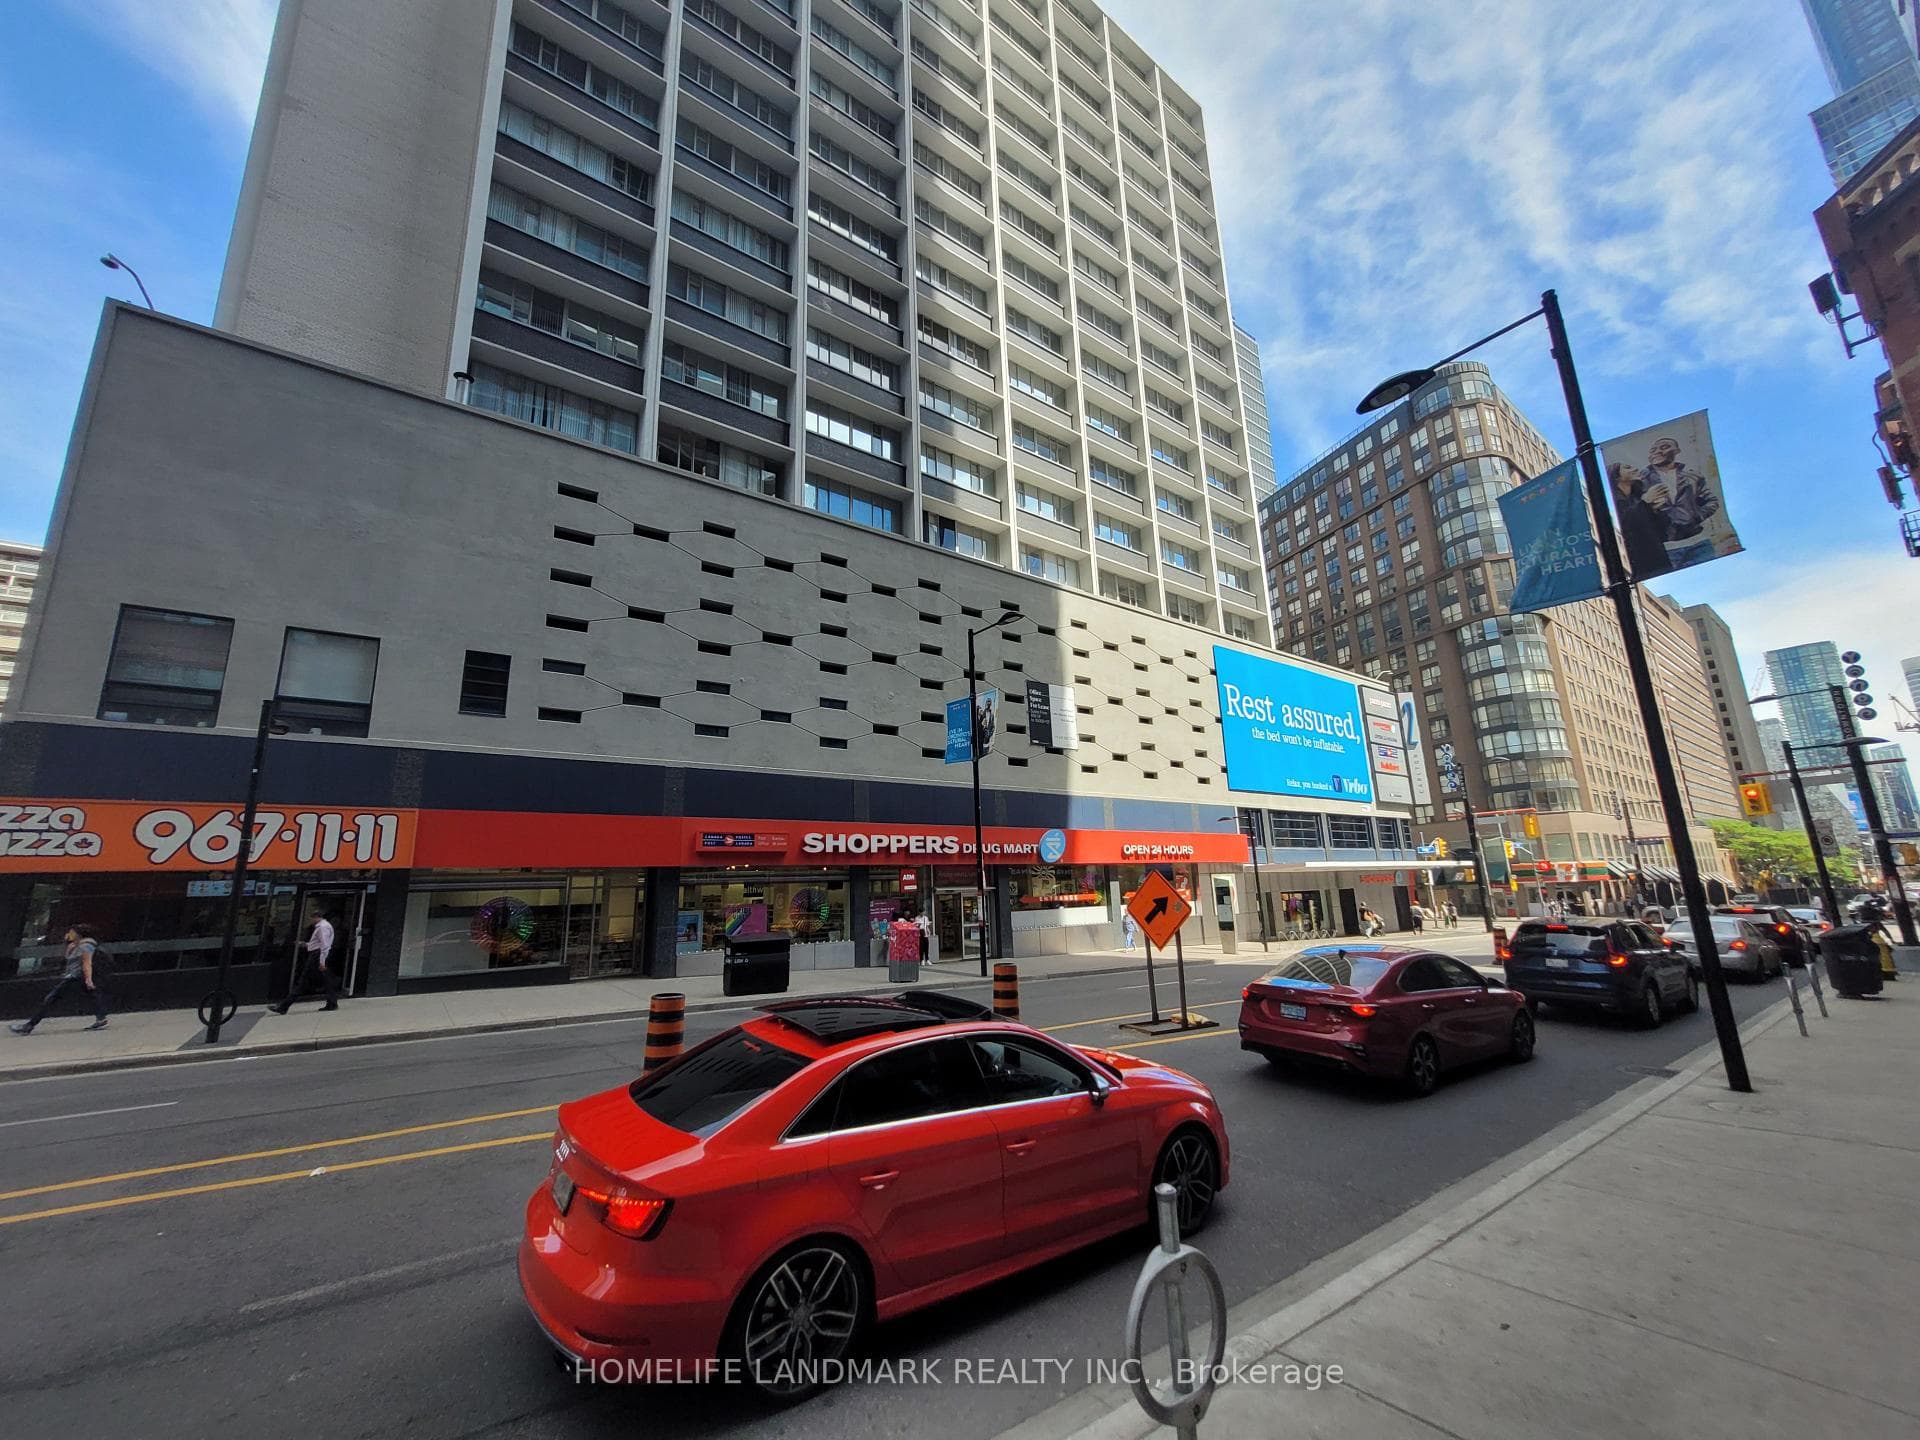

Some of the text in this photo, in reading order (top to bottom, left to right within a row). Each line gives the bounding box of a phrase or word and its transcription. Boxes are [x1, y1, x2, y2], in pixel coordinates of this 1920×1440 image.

[1541, 553, 1594, 575] HEART
[1223, 683, 1361, 744] Rest assured,
[1401, 701, 1419, 750] 2
[1251, 726, 1346, 754] the bed won't be inflatable.
[1342, 777, 1369, 795] Vrbo
[803, 832, 960, 854] SHOPPERS
[1004, 843, 1039, 854] MART
[1123, 844, 1194, 855] OPEN 24 HOURS
